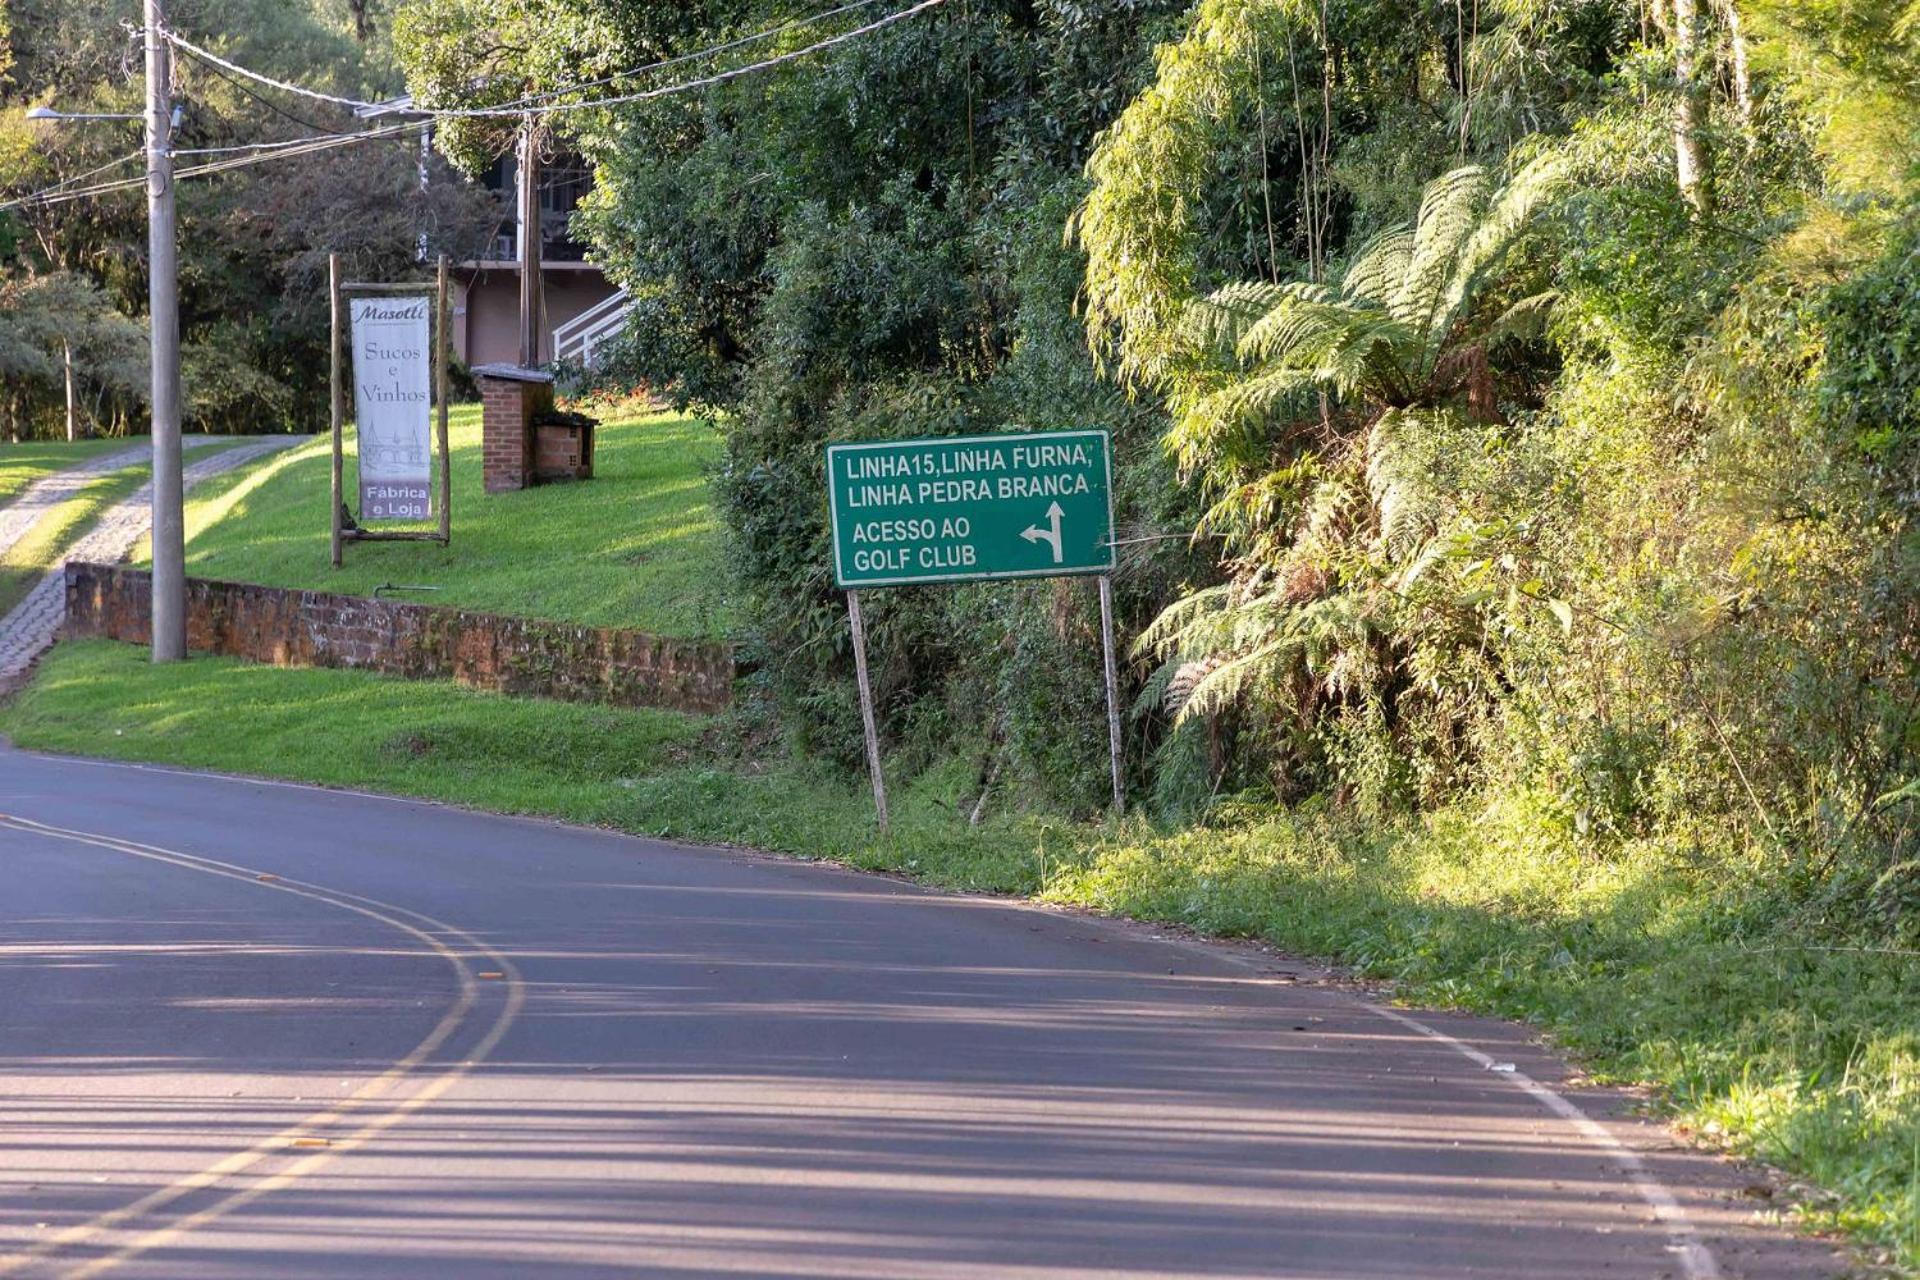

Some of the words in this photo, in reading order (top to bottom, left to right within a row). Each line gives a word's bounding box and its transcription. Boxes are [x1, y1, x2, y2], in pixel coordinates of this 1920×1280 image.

[355, 304, 425, 323] Masotti
[365, 342, 420, 360] Sucos
[388, 367, 397, 376] e
[362, 383, 426, 402] Vinhos
[1014, 444, 1093, 470] FURNA,
[849, 483, 912, 507] LINHA
[919, 479, 992, 504] PEDRA
[1000, 473, 1089, 499] BRANCA
[373, 506, 382, 514] e
[389, 503, 421, 516] Loja
[853, 518, 936, 543] ACESSO
[941, 517, 970, 538] AO
[854, 549, 910, 572] GOLF
[919, 545, 976, 568] CLUB
